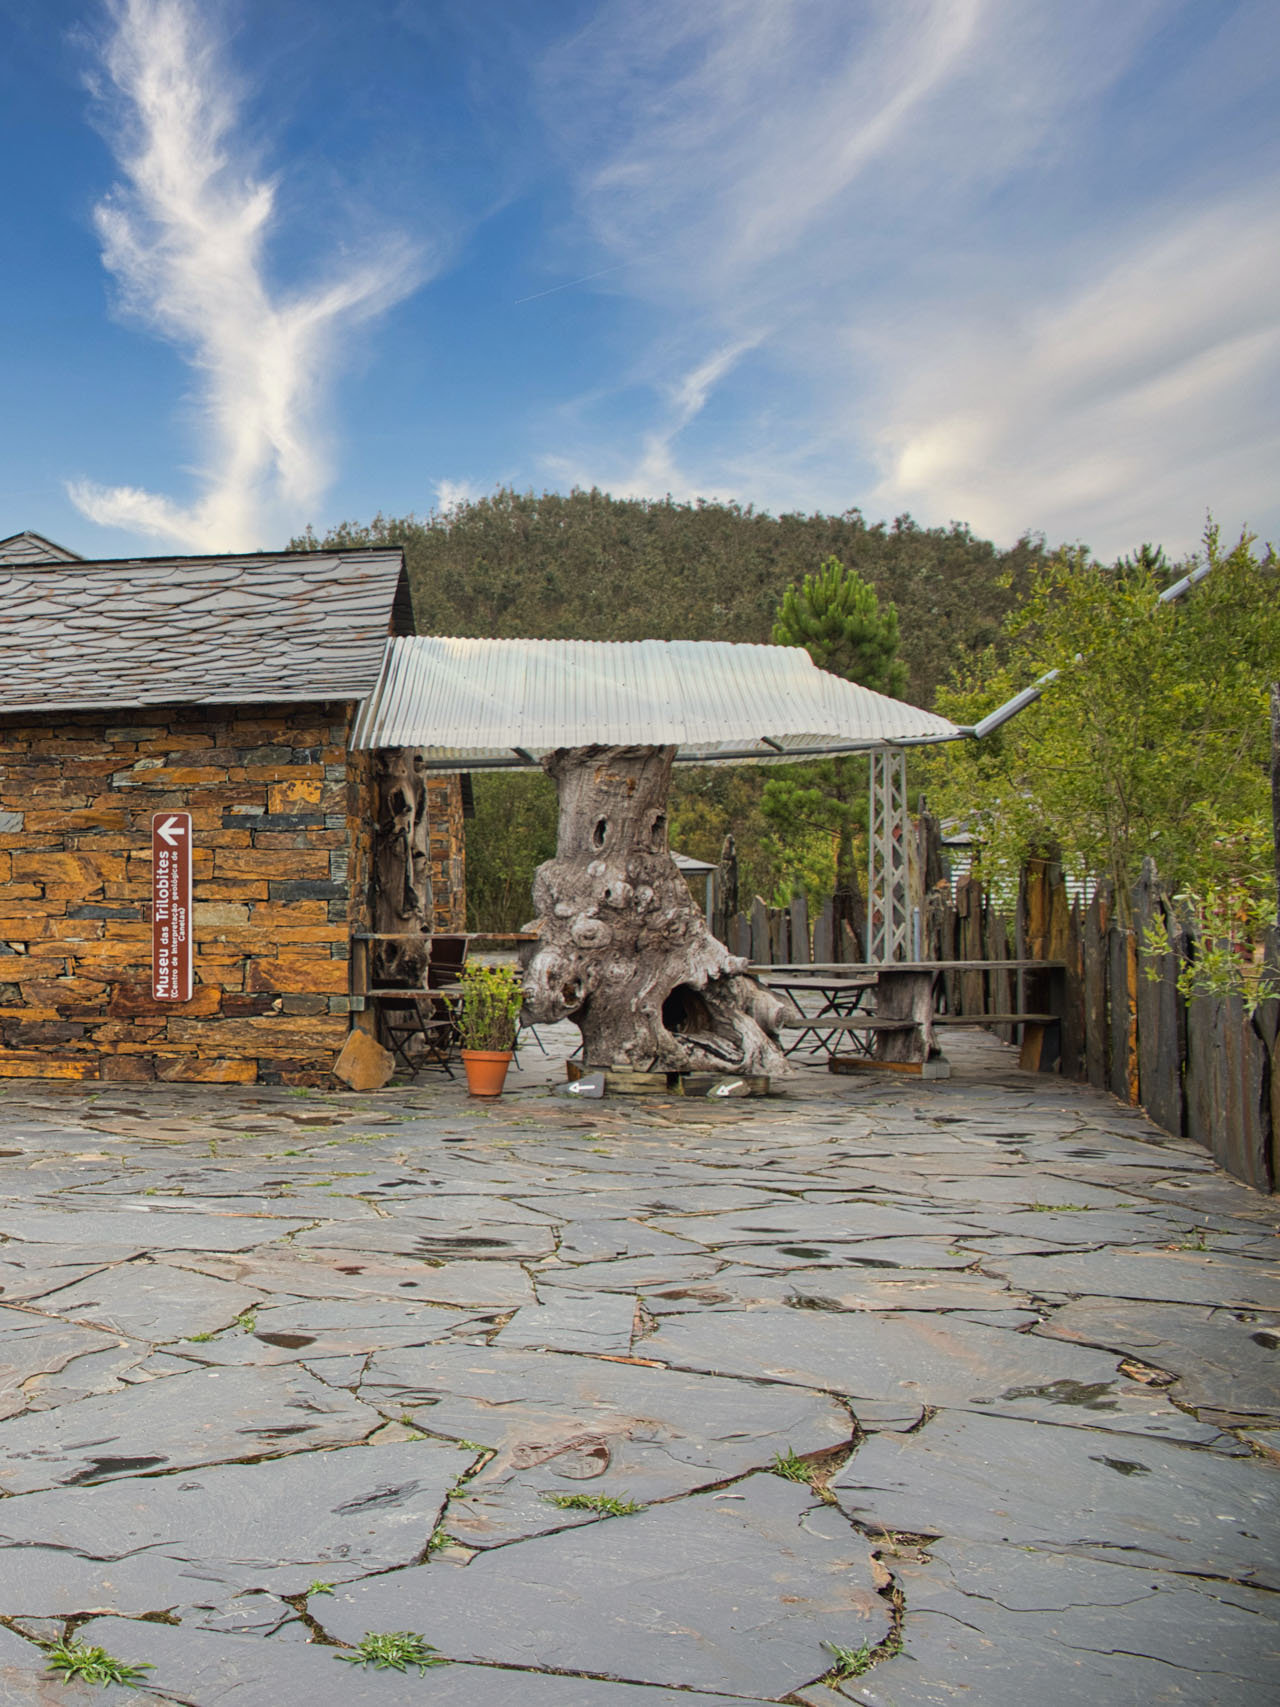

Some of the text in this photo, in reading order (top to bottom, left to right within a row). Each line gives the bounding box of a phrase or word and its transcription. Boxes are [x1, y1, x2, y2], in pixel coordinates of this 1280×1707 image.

[156, 850, 169, 998] Museu das Trilobites
[170, 851, 179, 998] (Centro de Interpretação geológica de
[178, 907, 186, 942] Canelas)
